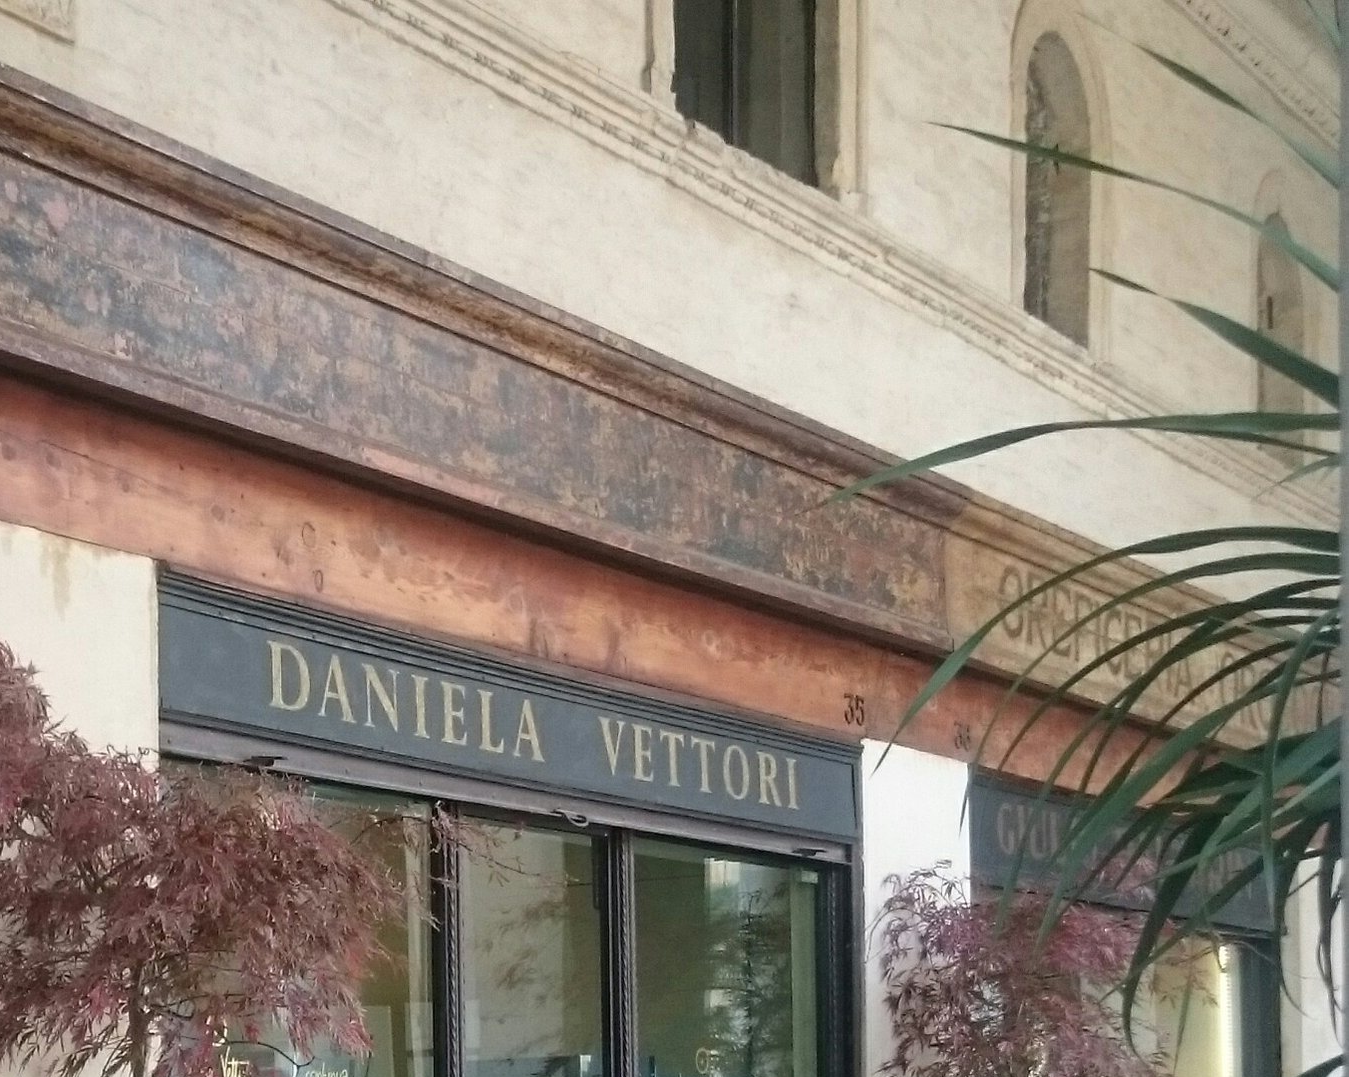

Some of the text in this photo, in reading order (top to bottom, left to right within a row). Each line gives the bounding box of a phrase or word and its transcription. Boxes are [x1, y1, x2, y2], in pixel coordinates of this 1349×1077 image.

[266, 639, 800, 811] DANIELA VETTORI
[843, 693, 865, 726] 35
